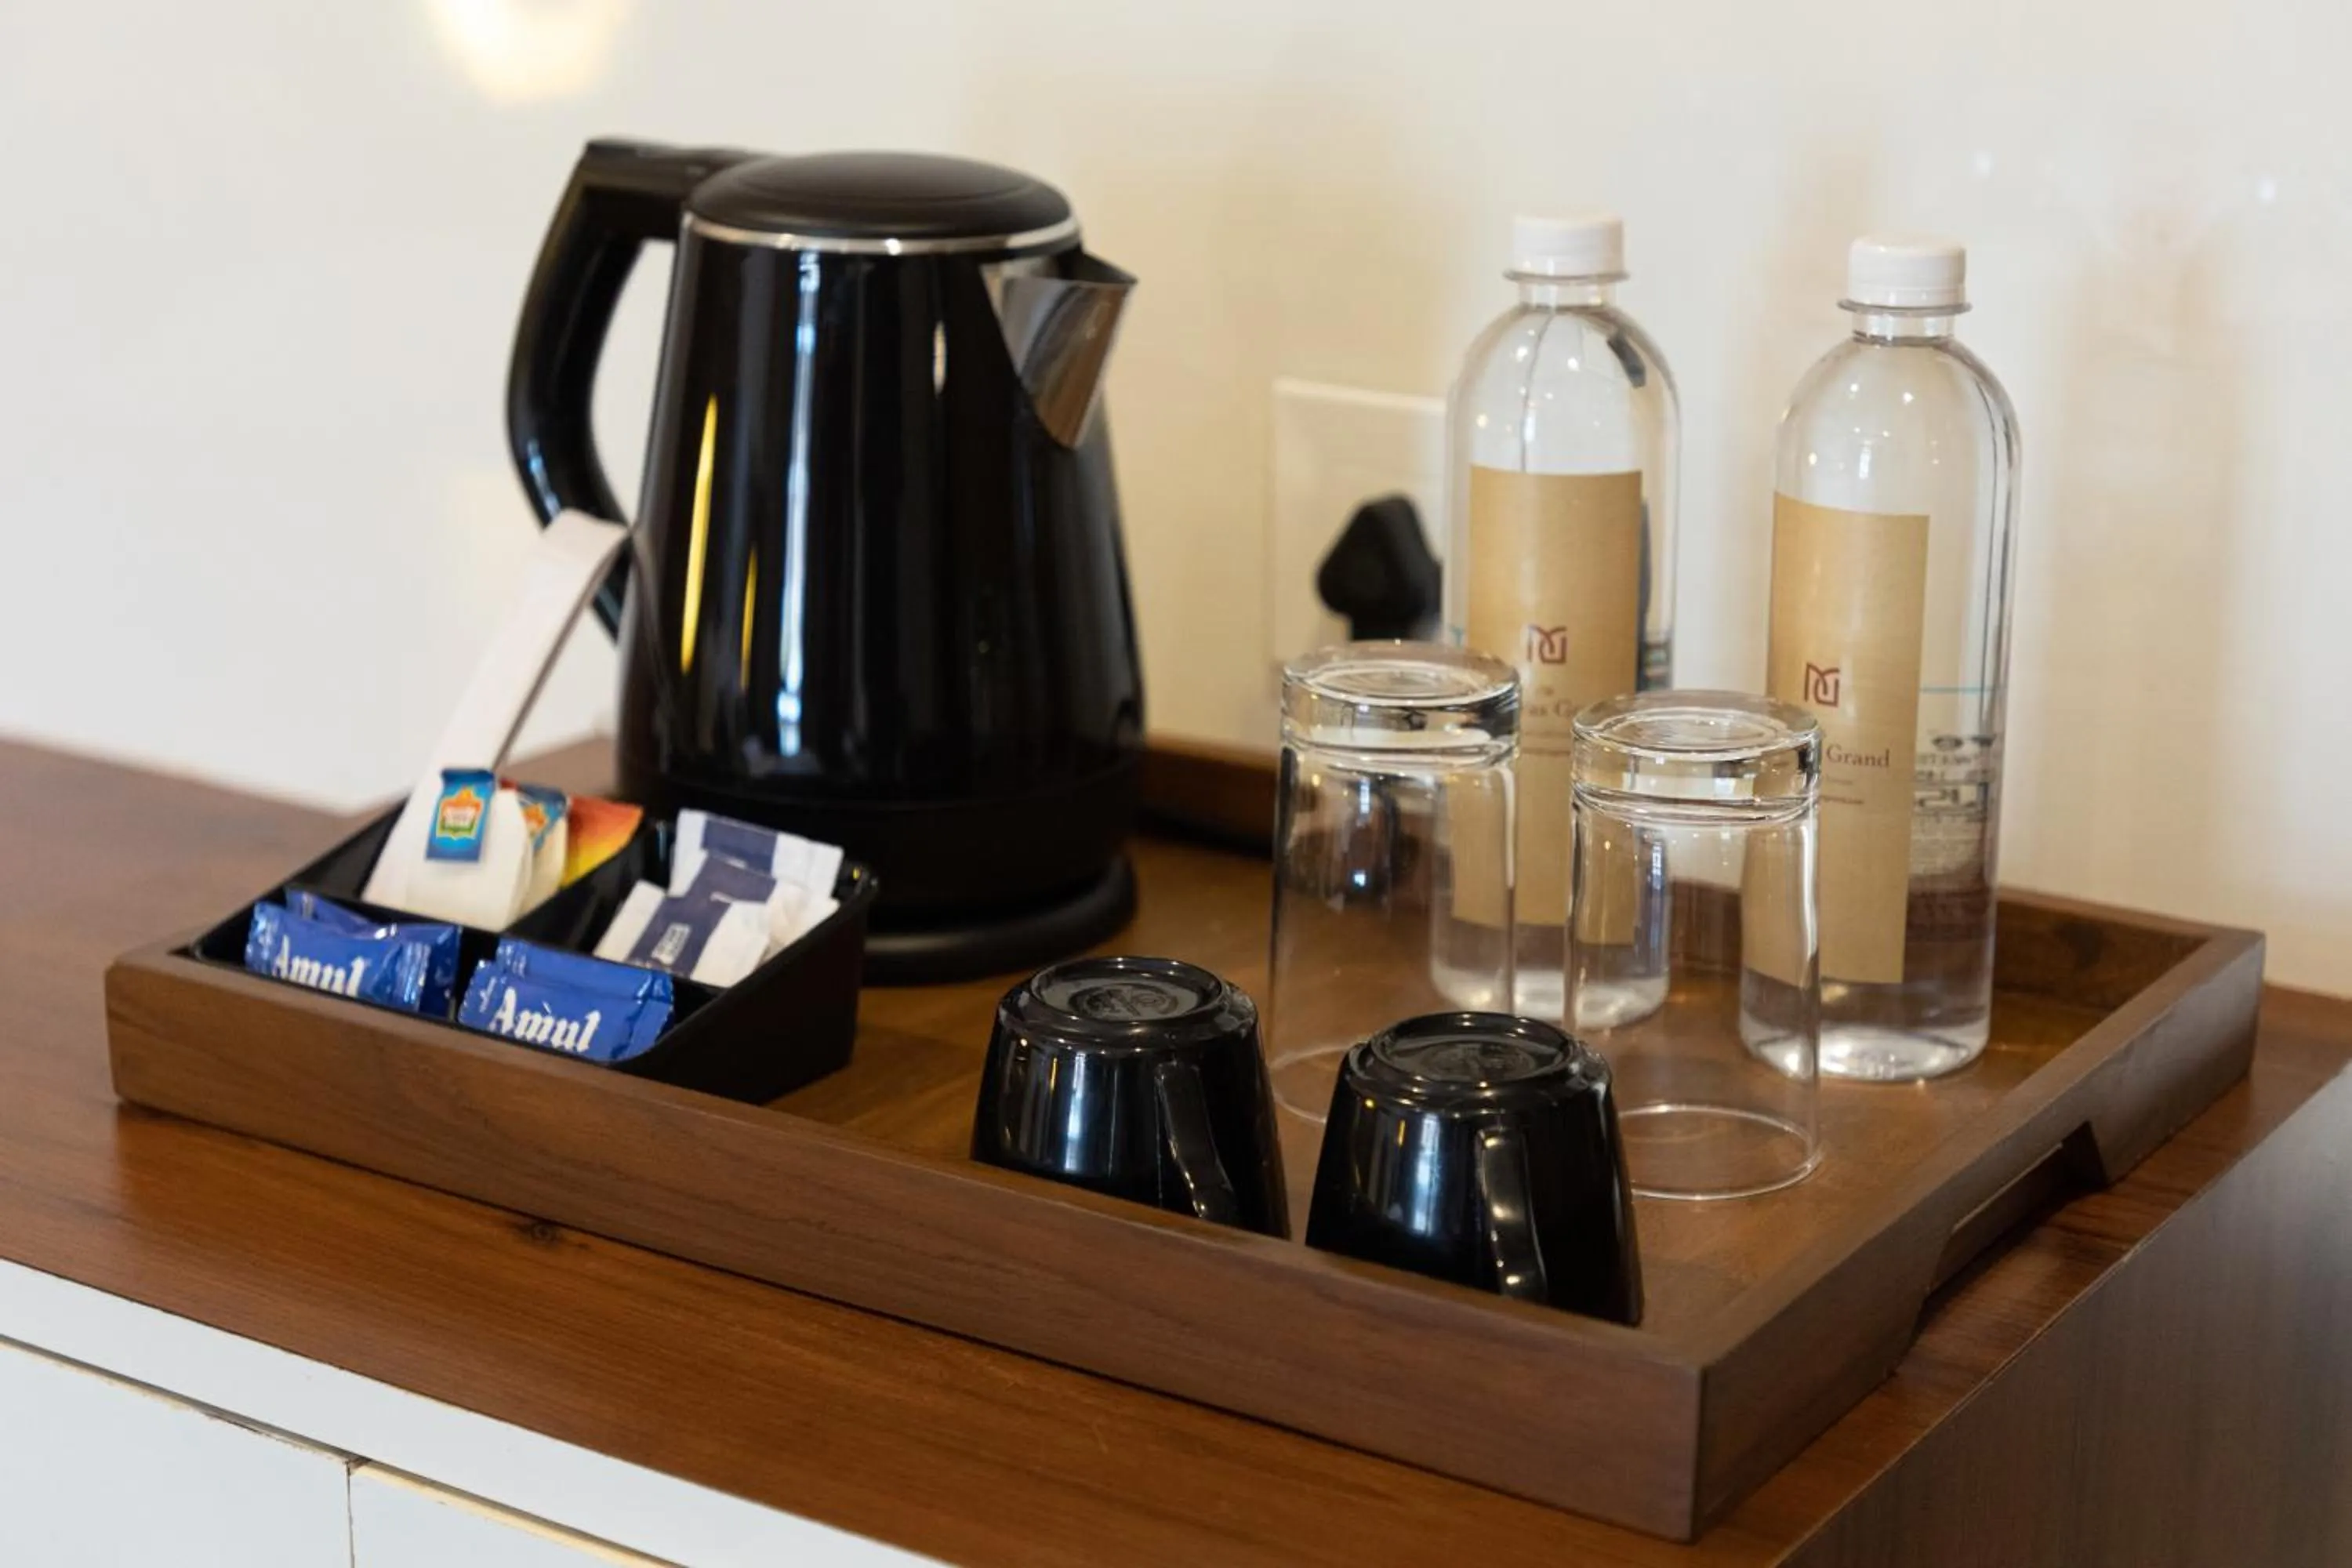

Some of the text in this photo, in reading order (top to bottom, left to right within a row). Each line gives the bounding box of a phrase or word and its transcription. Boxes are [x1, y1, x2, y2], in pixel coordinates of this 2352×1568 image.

[1826, 744, 1890, 768] Grand
[272, 934, 369, 997] Amul
[487, 985, 602, 1053] Amul
